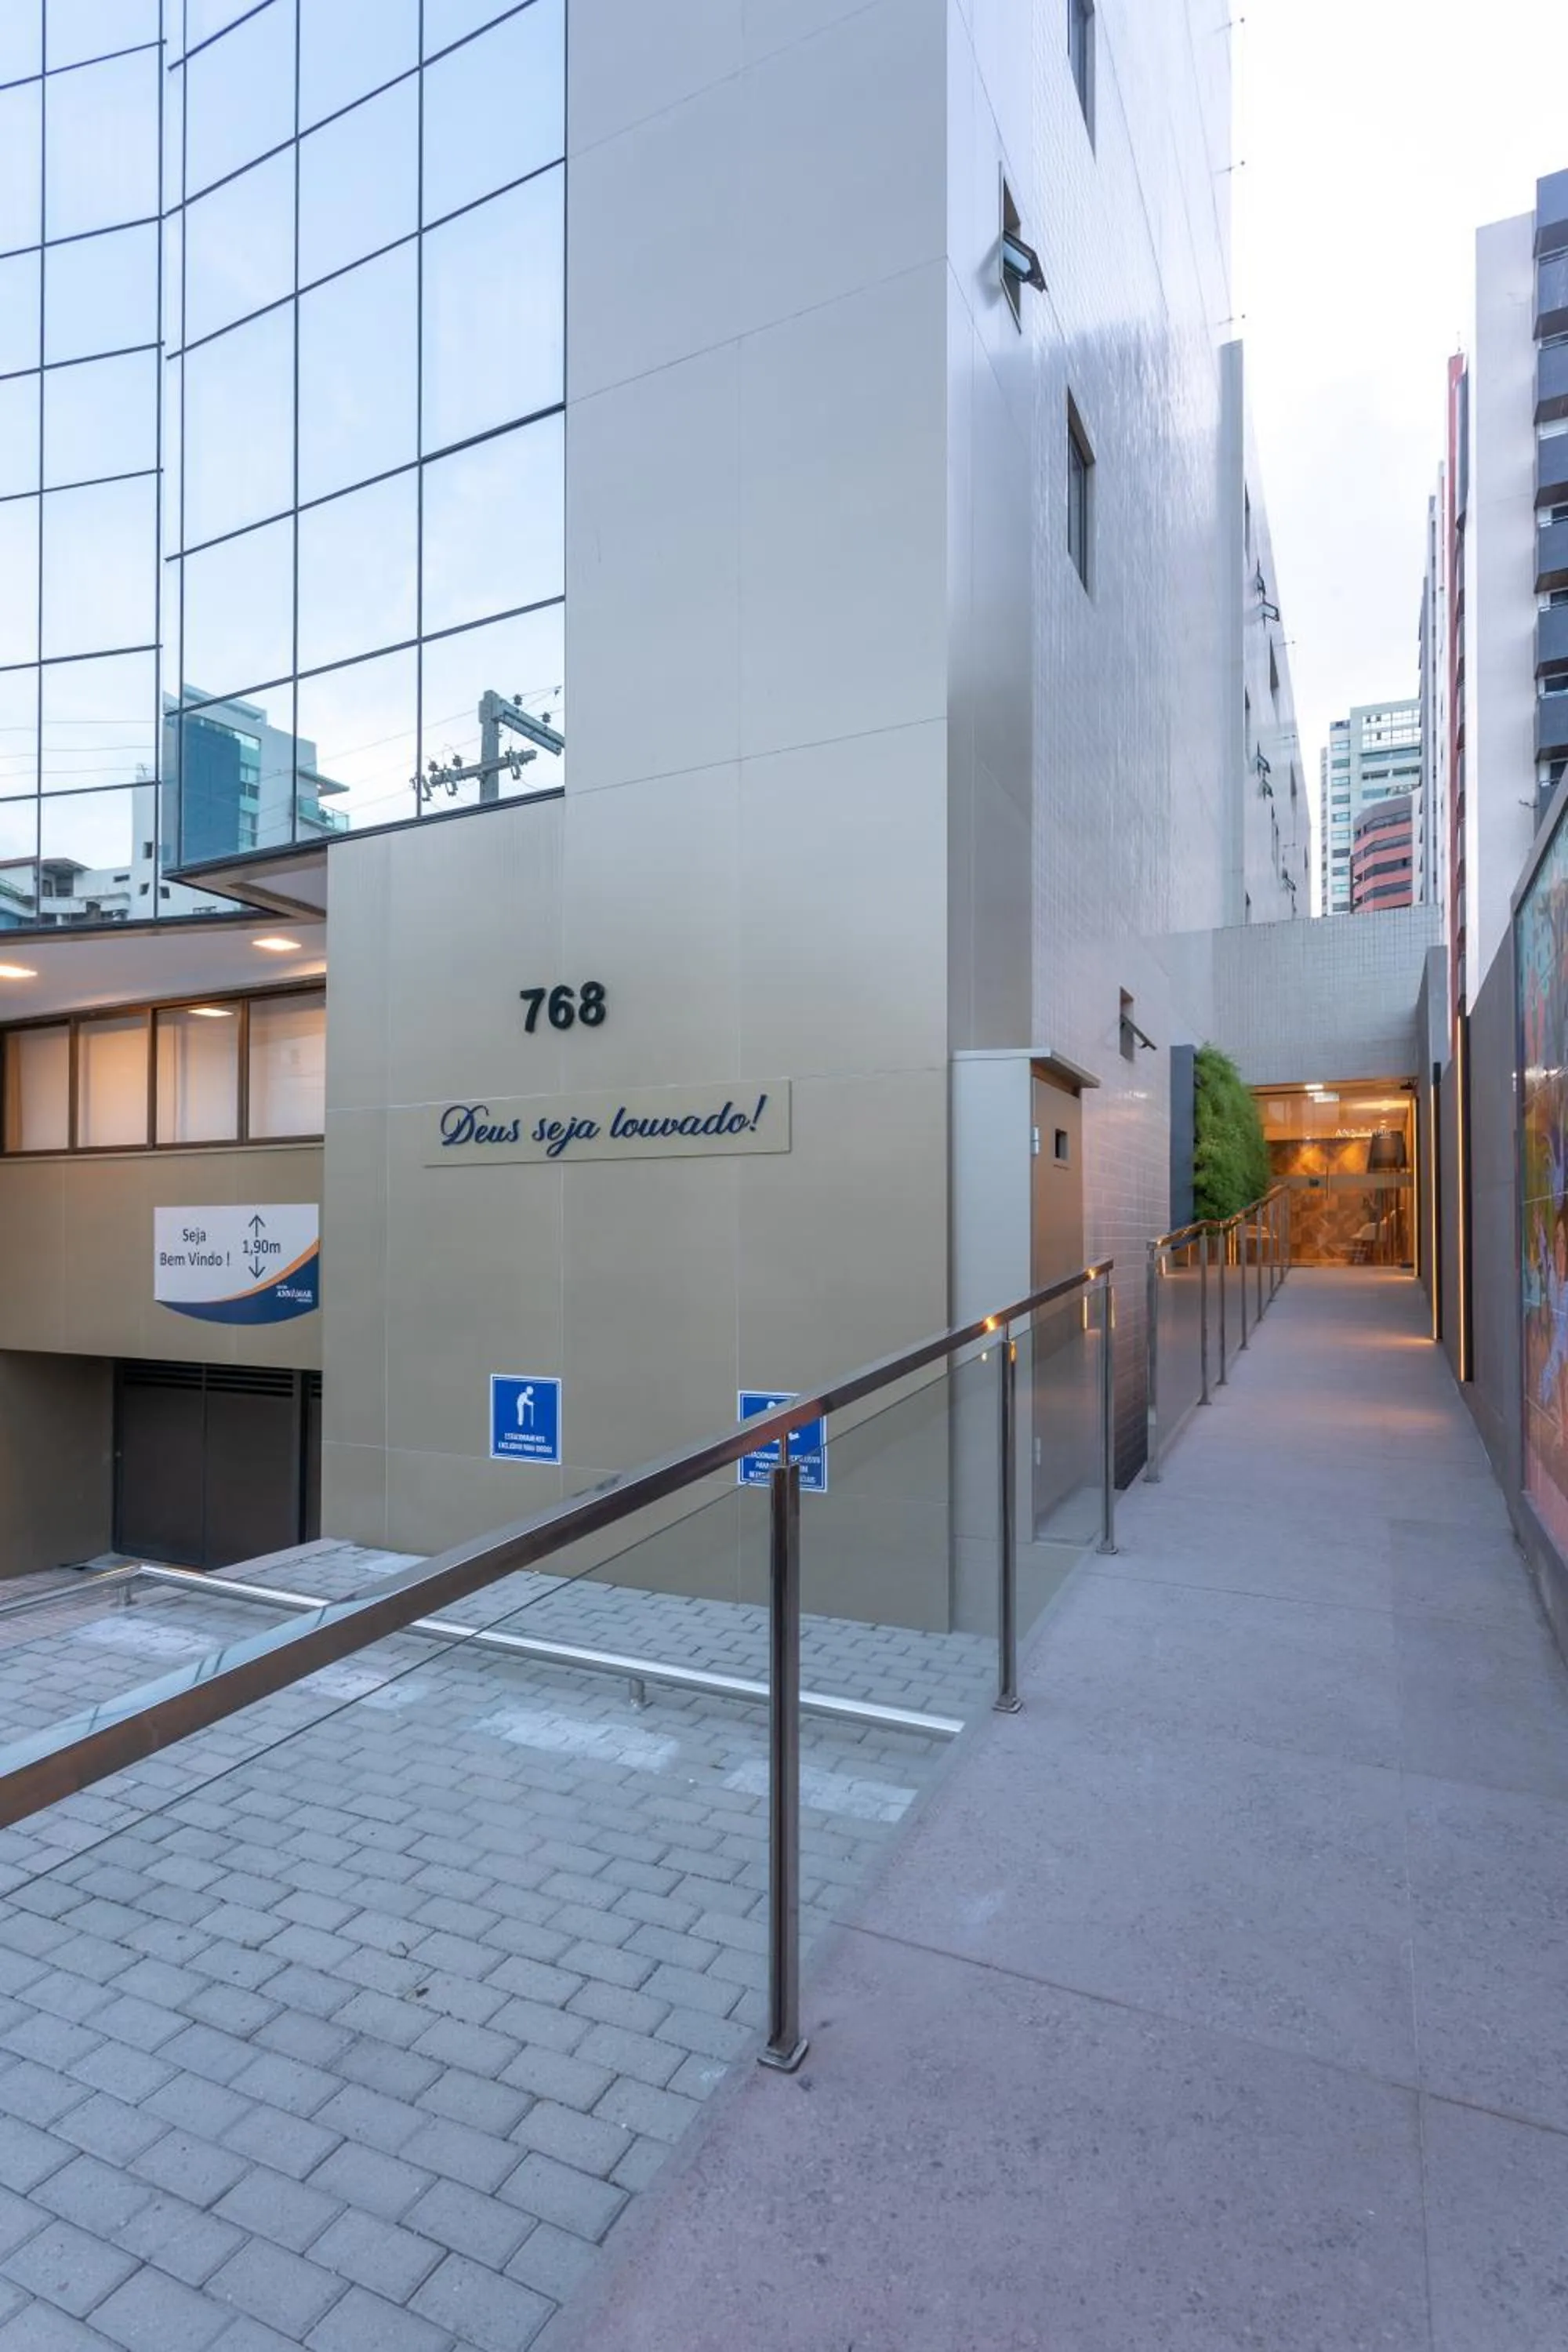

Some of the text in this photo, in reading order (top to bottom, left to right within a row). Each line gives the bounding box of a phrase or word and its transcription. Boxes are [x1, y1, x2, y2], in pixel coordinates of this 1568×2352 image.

[520, 982, 606, 1033] 768
[440, 1094, 768, 1157] Deus seja louvado!
[182, 1228, 207, 1245] Seja
[242, 1239, 281, 1255] 1,90m
[160, 1252, 186, 1266] Bem
[187, 1251, 223, 1267] Vindo
